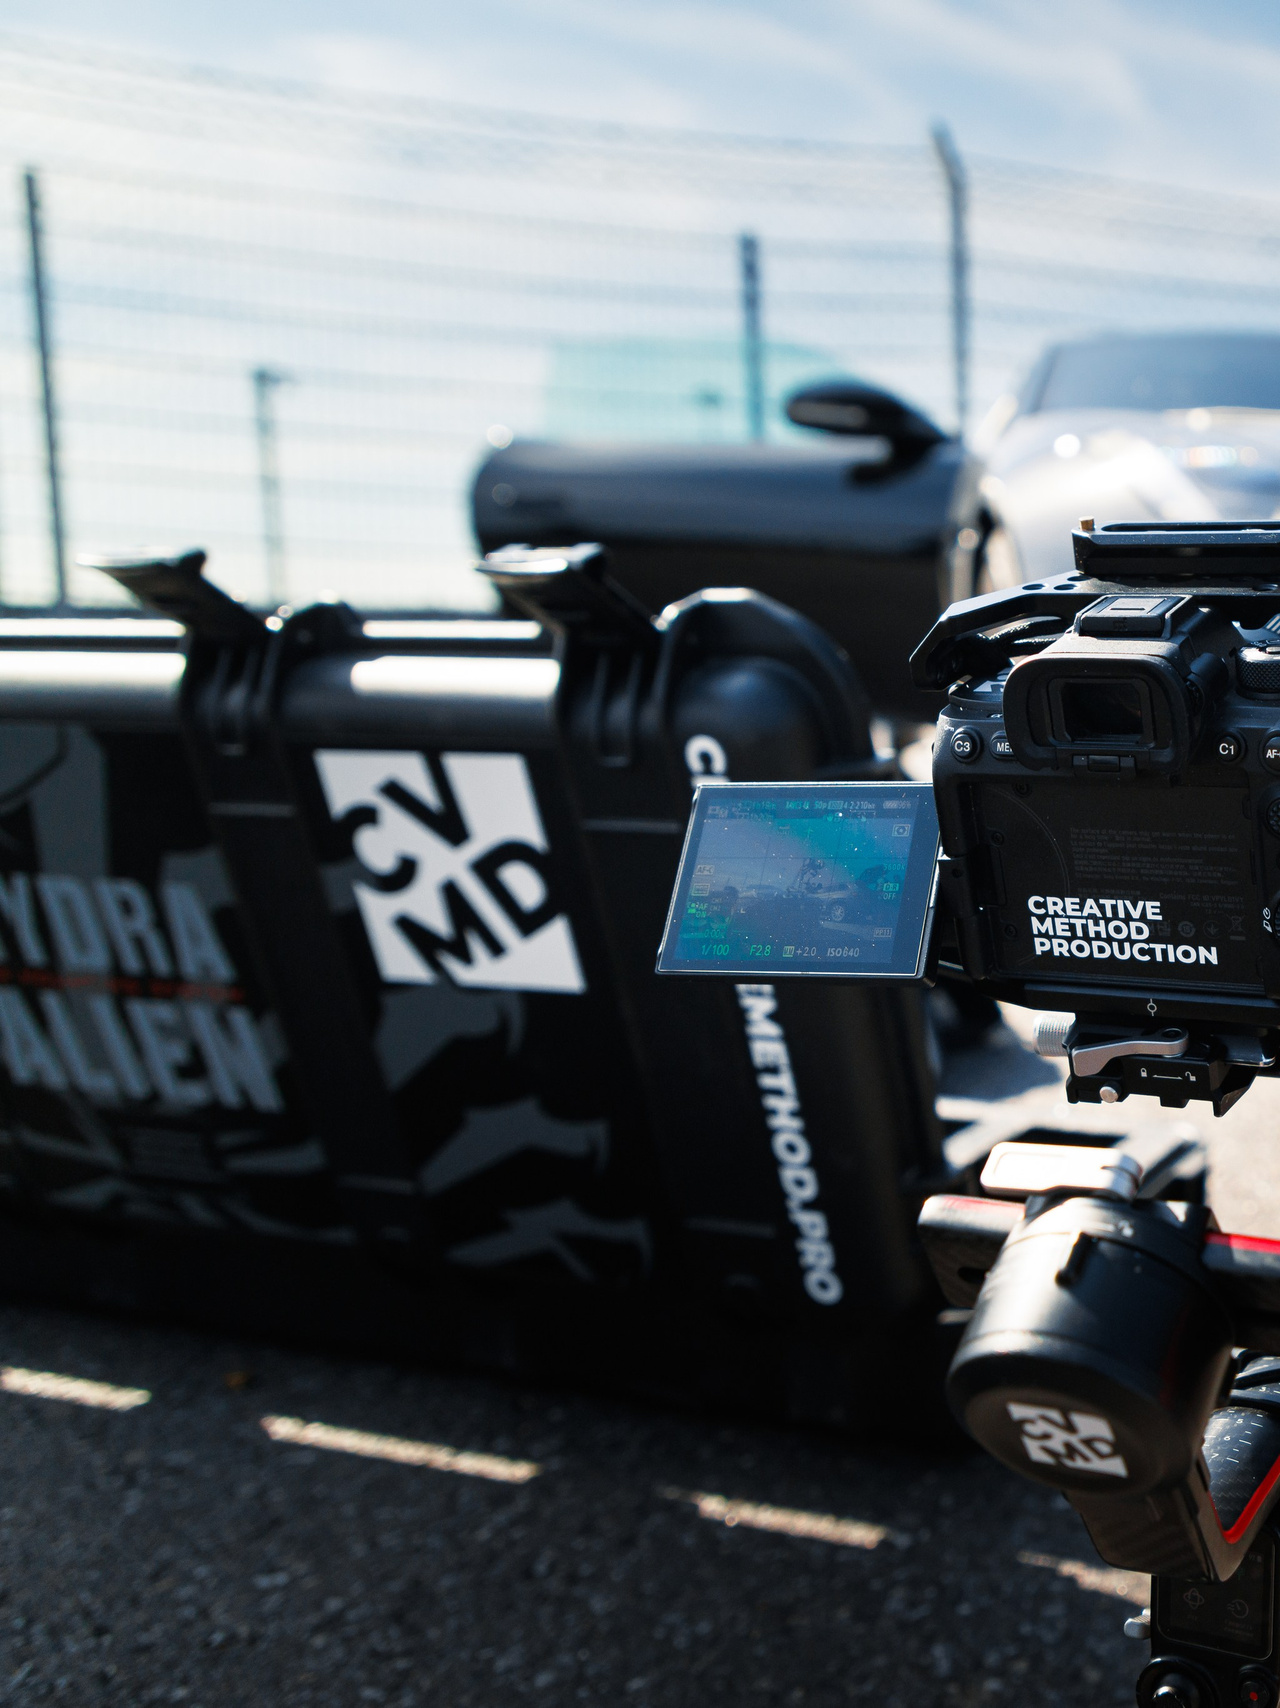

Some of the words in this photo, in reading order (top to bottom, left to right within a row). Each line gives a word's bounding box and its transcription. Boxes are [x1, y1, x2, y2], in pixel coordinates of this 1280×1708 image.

[954, 741, 971, 752] C3
[996, 743, 1012, 752] ME
[1219, 743, 1234, 755] C1
[1028, 896, 1163, 921] CREATIVE
[0, 873, 237, 978] YDRA
[1031, 917, 1150, 940] METHOD
[701, 944, 730, 956] 1/100
[1034, 938, 1219, 965] PRODUCTION
[0, 988, 284, 1113] ALIEN
